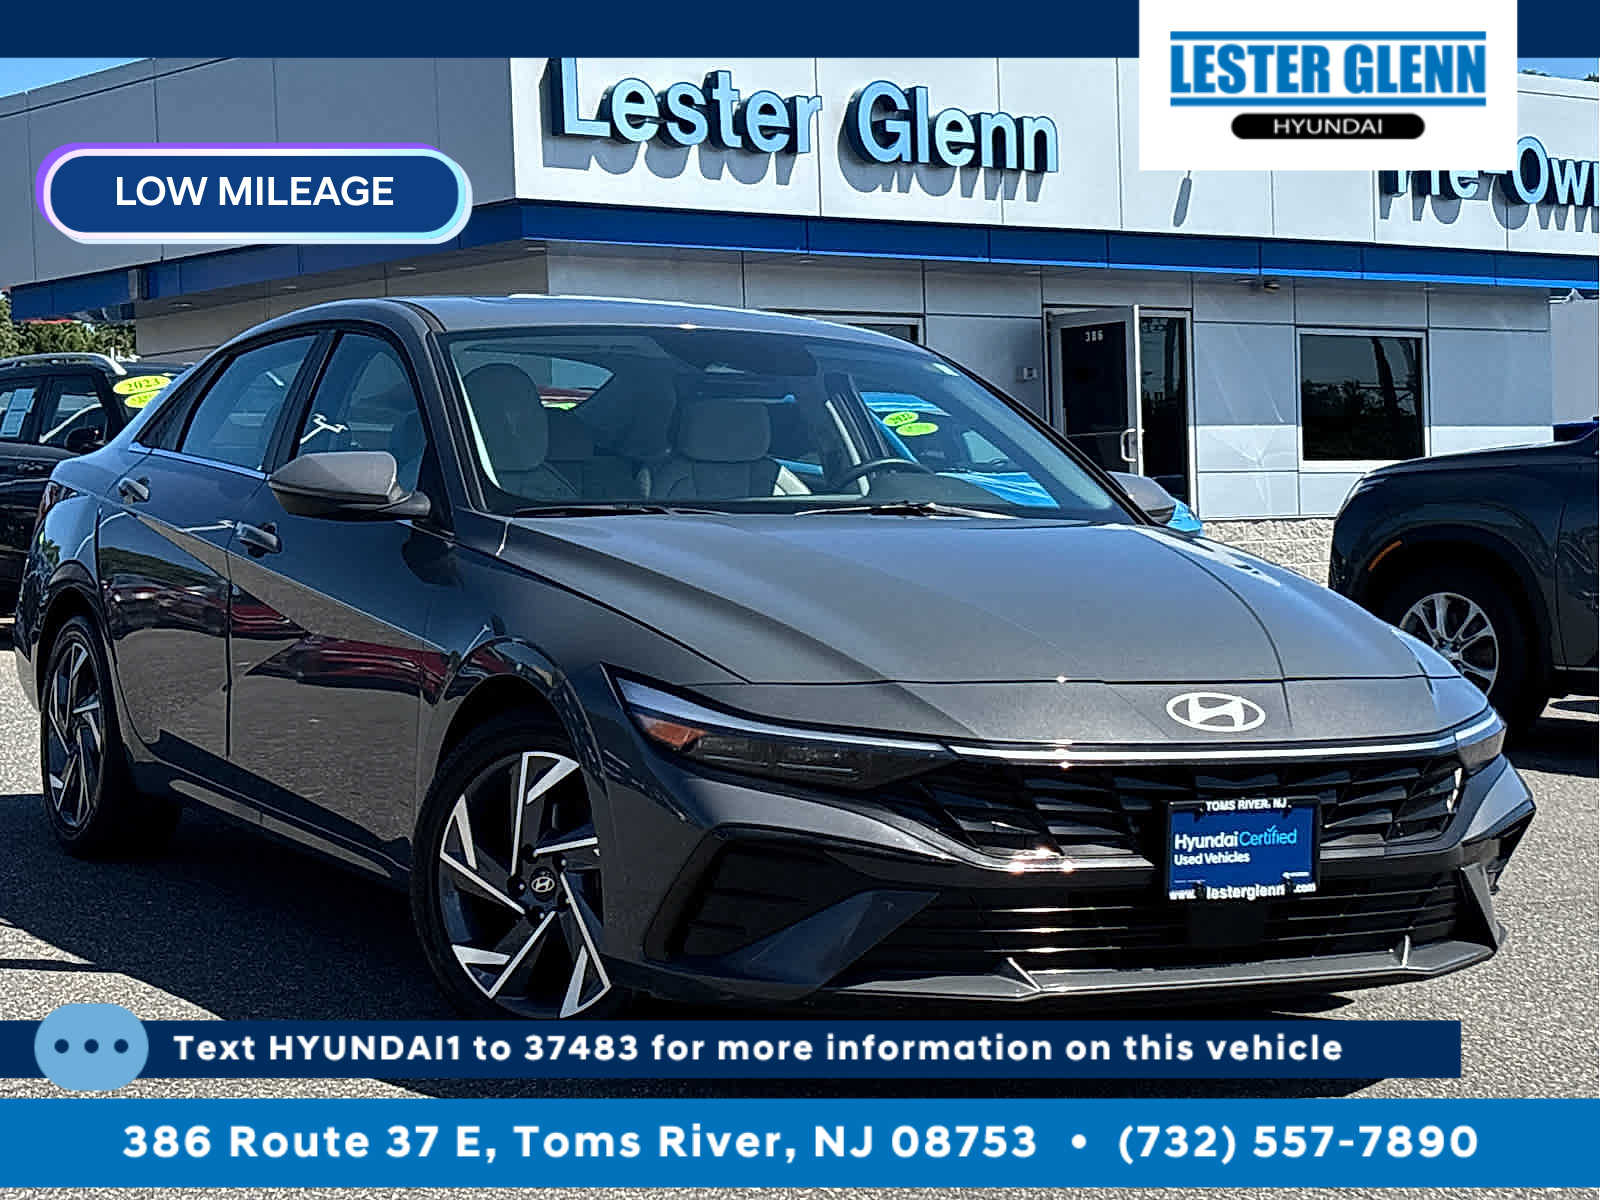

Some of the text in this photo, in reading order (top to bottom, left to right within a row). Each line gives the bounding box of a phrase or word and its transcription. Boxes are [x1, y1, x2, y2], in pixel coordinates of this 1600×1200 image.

[556, 57, 1059, 173] Lester Glenn
[1205, 801, 1236, 812] TOMS
[1273, 798, 1287, 809] NJ
[1174, 825, 1298, 852] Hyundai Certified
[1174, 851, 1251, 866] Used Vehicles
[1206, 883, 1286, 901] lesterglenn
